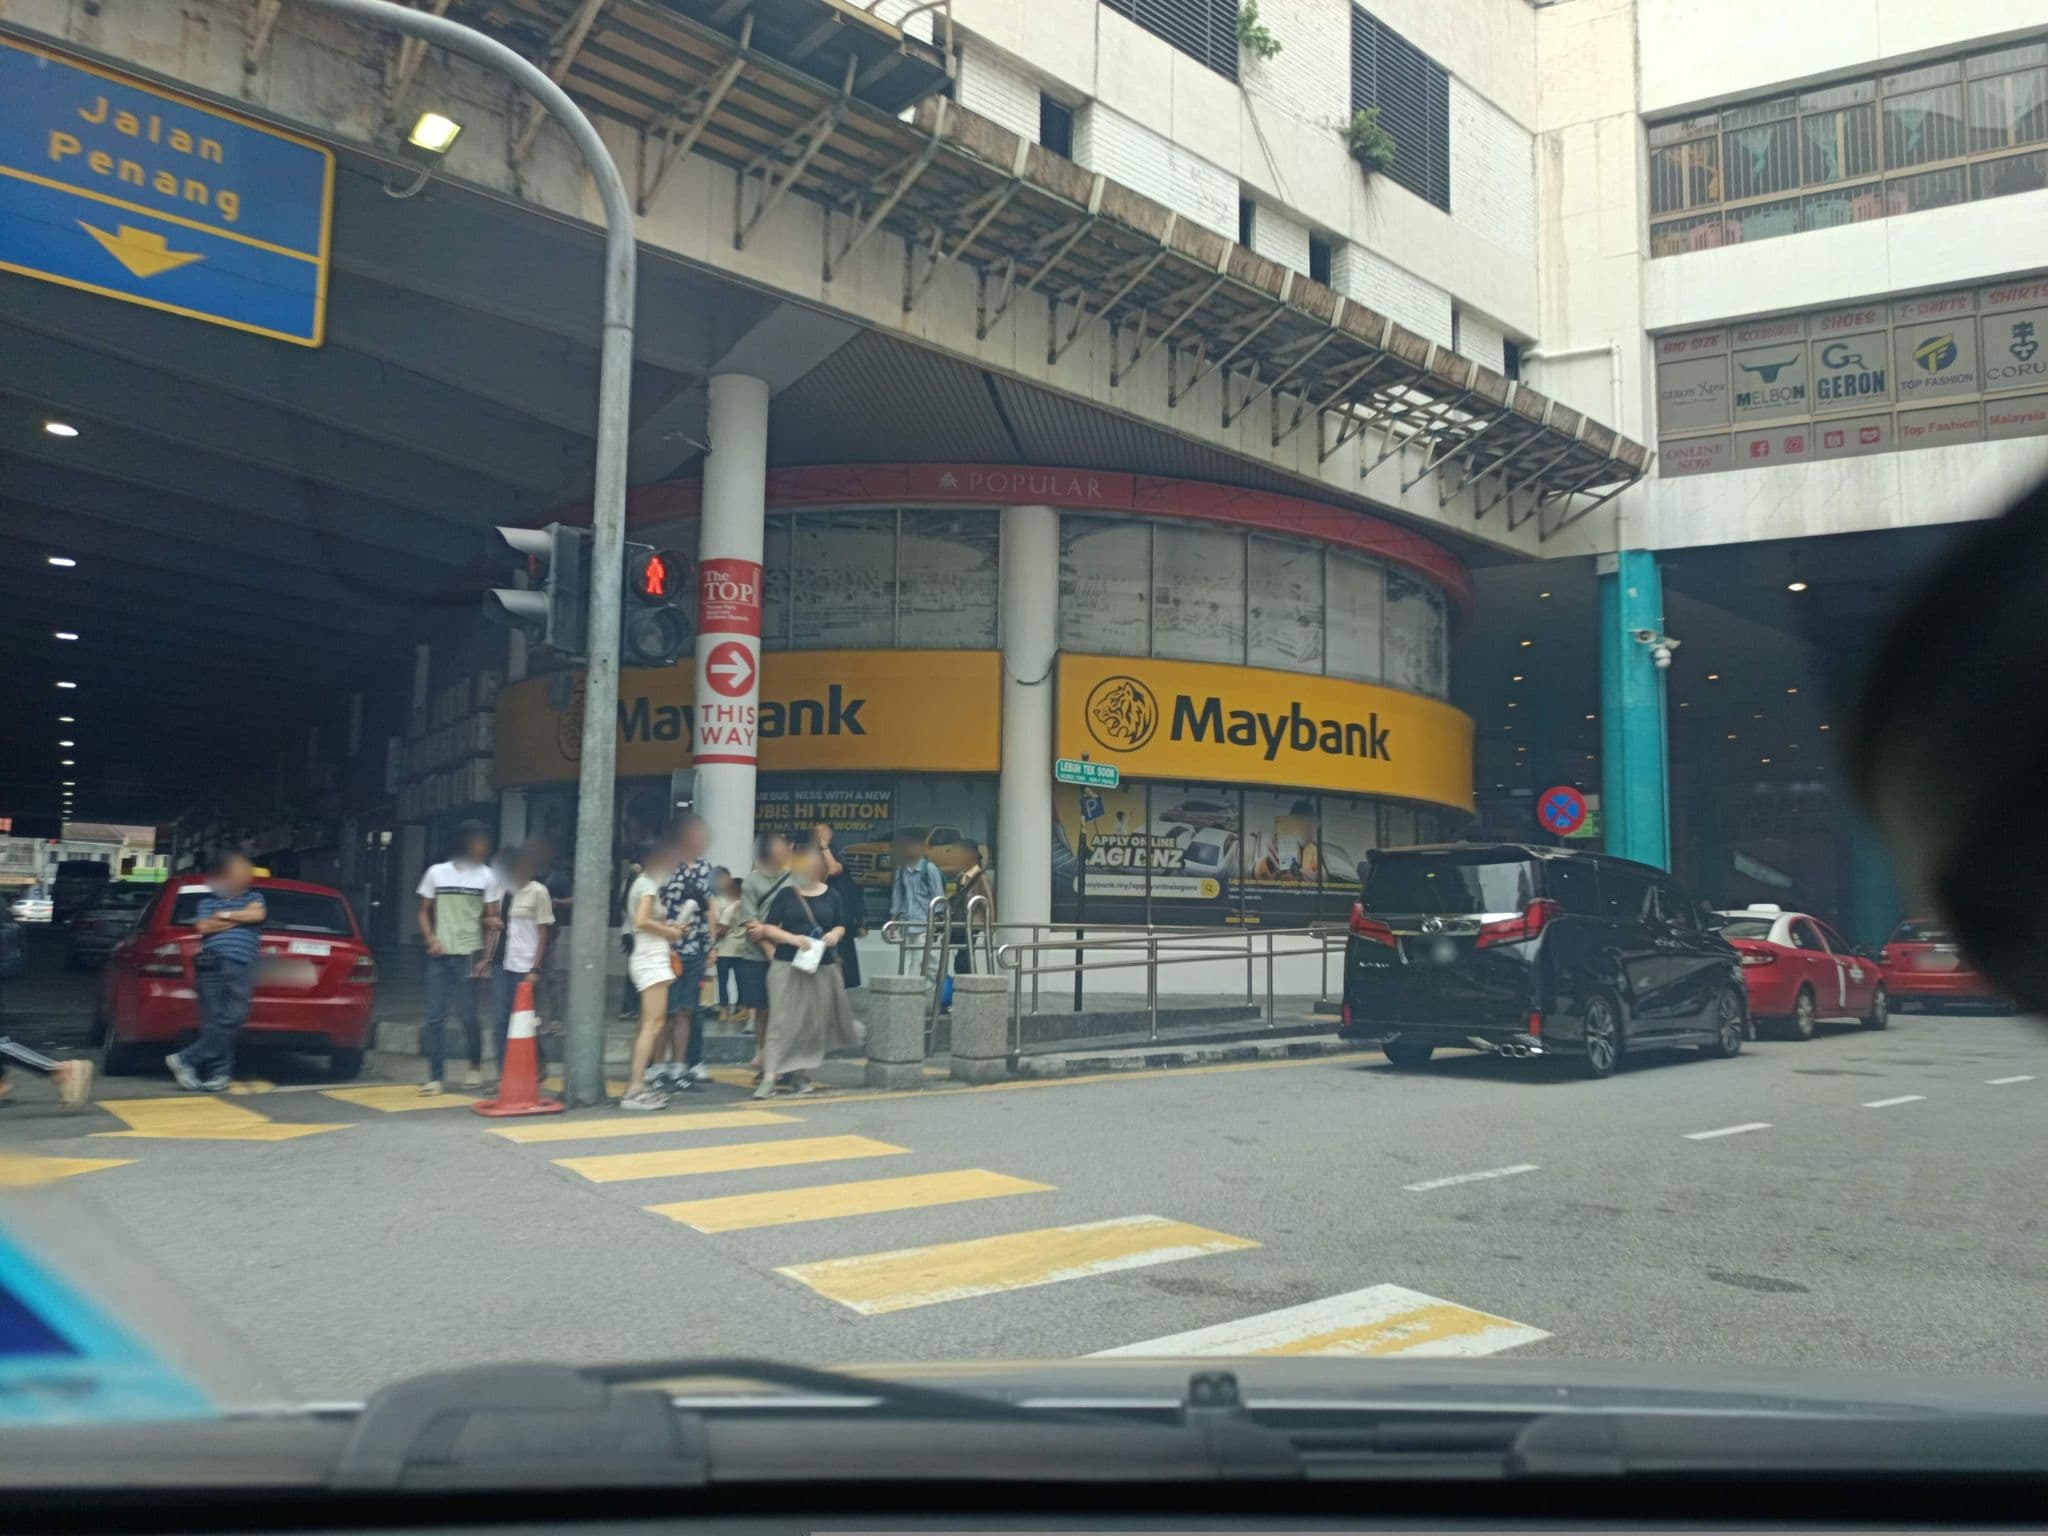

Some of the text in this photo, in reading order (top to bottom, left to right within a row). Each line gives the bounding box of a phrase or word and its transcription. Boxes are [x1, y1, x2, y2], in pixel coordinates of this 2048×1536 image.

[78, 96, 224, 164] Jalan
[48, 129, 240, 222] Penang
[1989, 284, 2048, 304] SHIRTS
[1821, 311, 1876, 330] SHOES
[1817, 370, 1885, 400] GERON
[1902, 373, 1973, 392] TOP FASHION
[1736, 385, 1805, 407] MELBON
[1904, 410, 2047, 438] Top Fashion Malaysia
[1665, 443, 1722, 459] ONLINE
[970, 472, 1102, 498] POPULAR
[704, 571, 729, 582] The
[704, 582, 752, 602] TOP
[616, 684, 867, 752] Mayank
[701, 704, 755, 724] THIS
[701, 727, 754, 746] WAY
[1170, 694, 1391, 761] Maybank
[769, 791, 822, 801] BUSNESS
[825, 791, 853, 800] WITH
[854, 791, 863, 800] A
[865, 791, 891, 800] NEW
[819, 803, 889, 819] TRITON
[1092, 835, 1130, 848] APPLY
